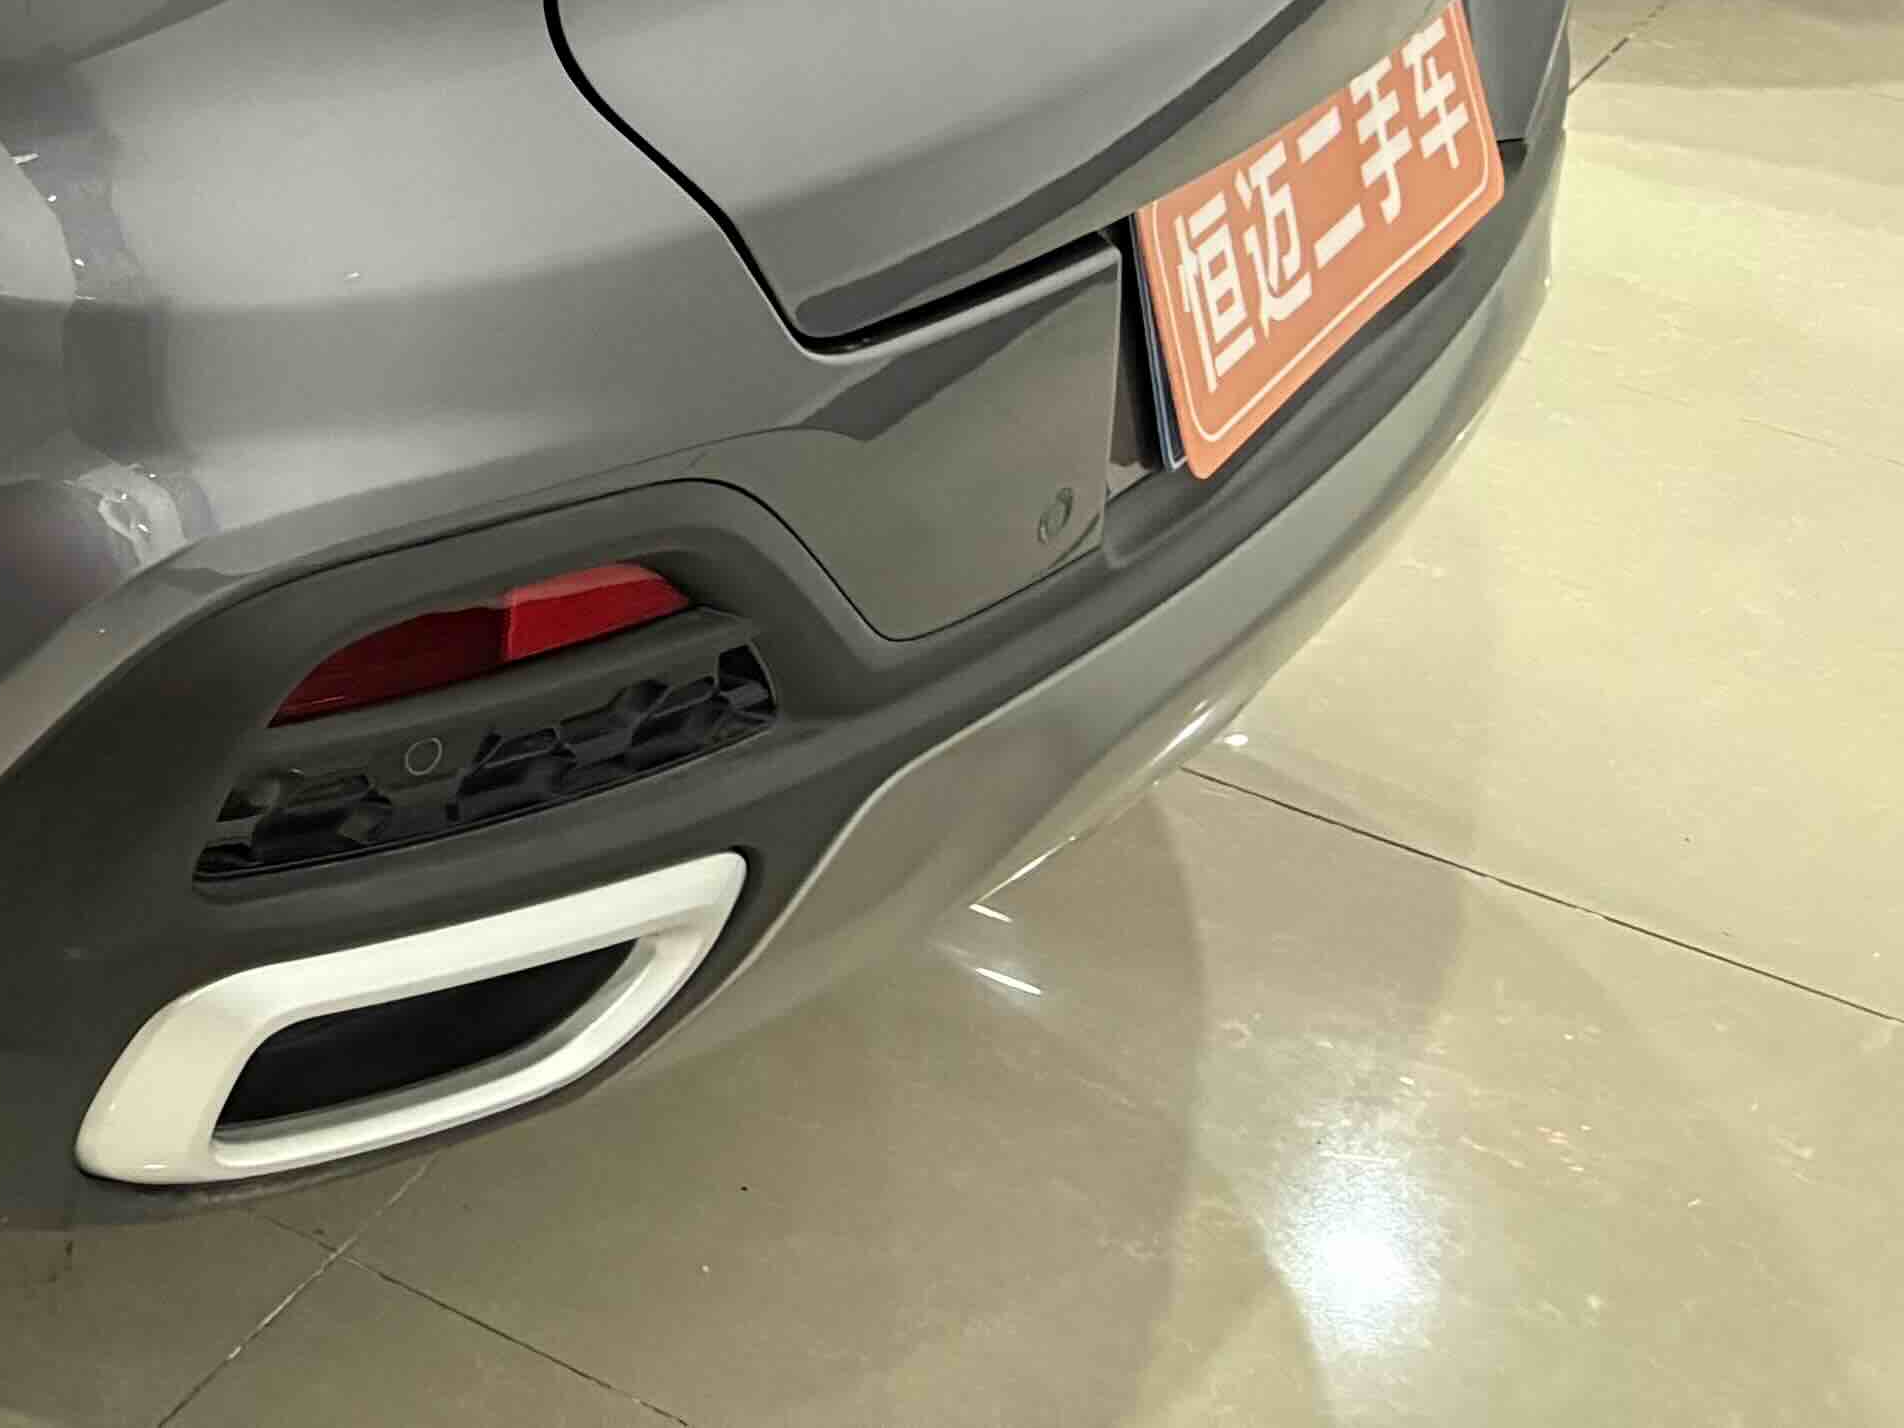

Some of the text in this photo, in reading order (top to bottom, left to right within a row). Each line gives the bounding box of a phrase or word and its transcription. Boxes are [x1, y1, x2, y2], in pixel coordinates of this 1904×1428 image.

[1175, 18, 1469, 393] 恒迈二手车
